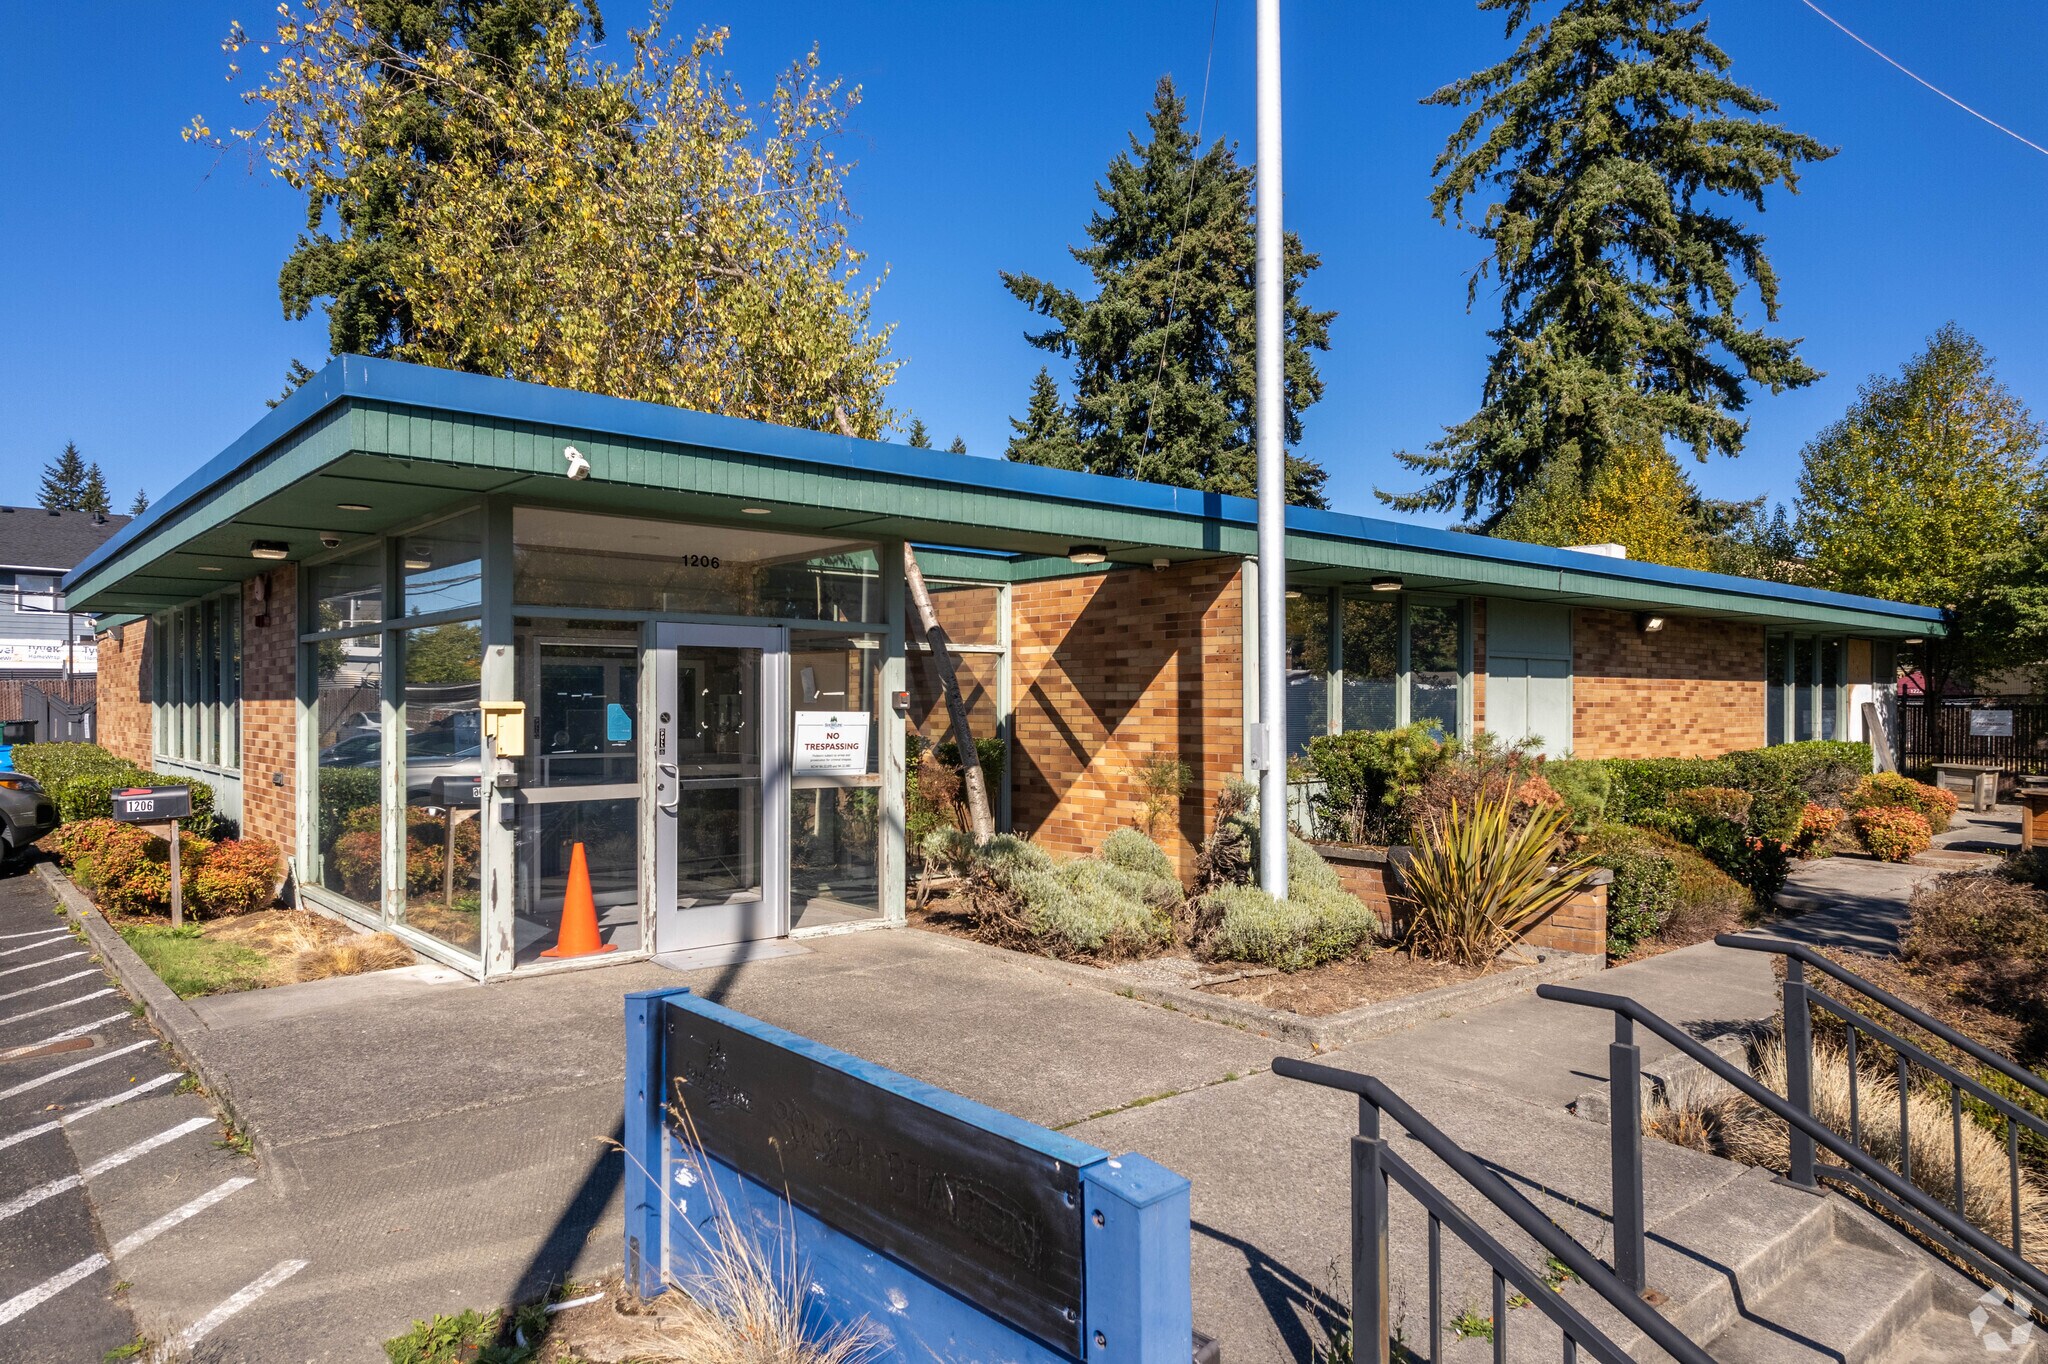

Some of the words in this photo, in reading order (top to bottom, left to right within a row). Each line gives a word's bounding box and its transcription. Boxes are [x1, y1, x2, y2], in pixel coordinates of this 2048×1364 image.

[681, 554, 720, 569] 1206
[826, 732, 840, 740] NO
[804, 743, 859, 751] TRESPASSING
[128, 801, 153, 812] 1206
